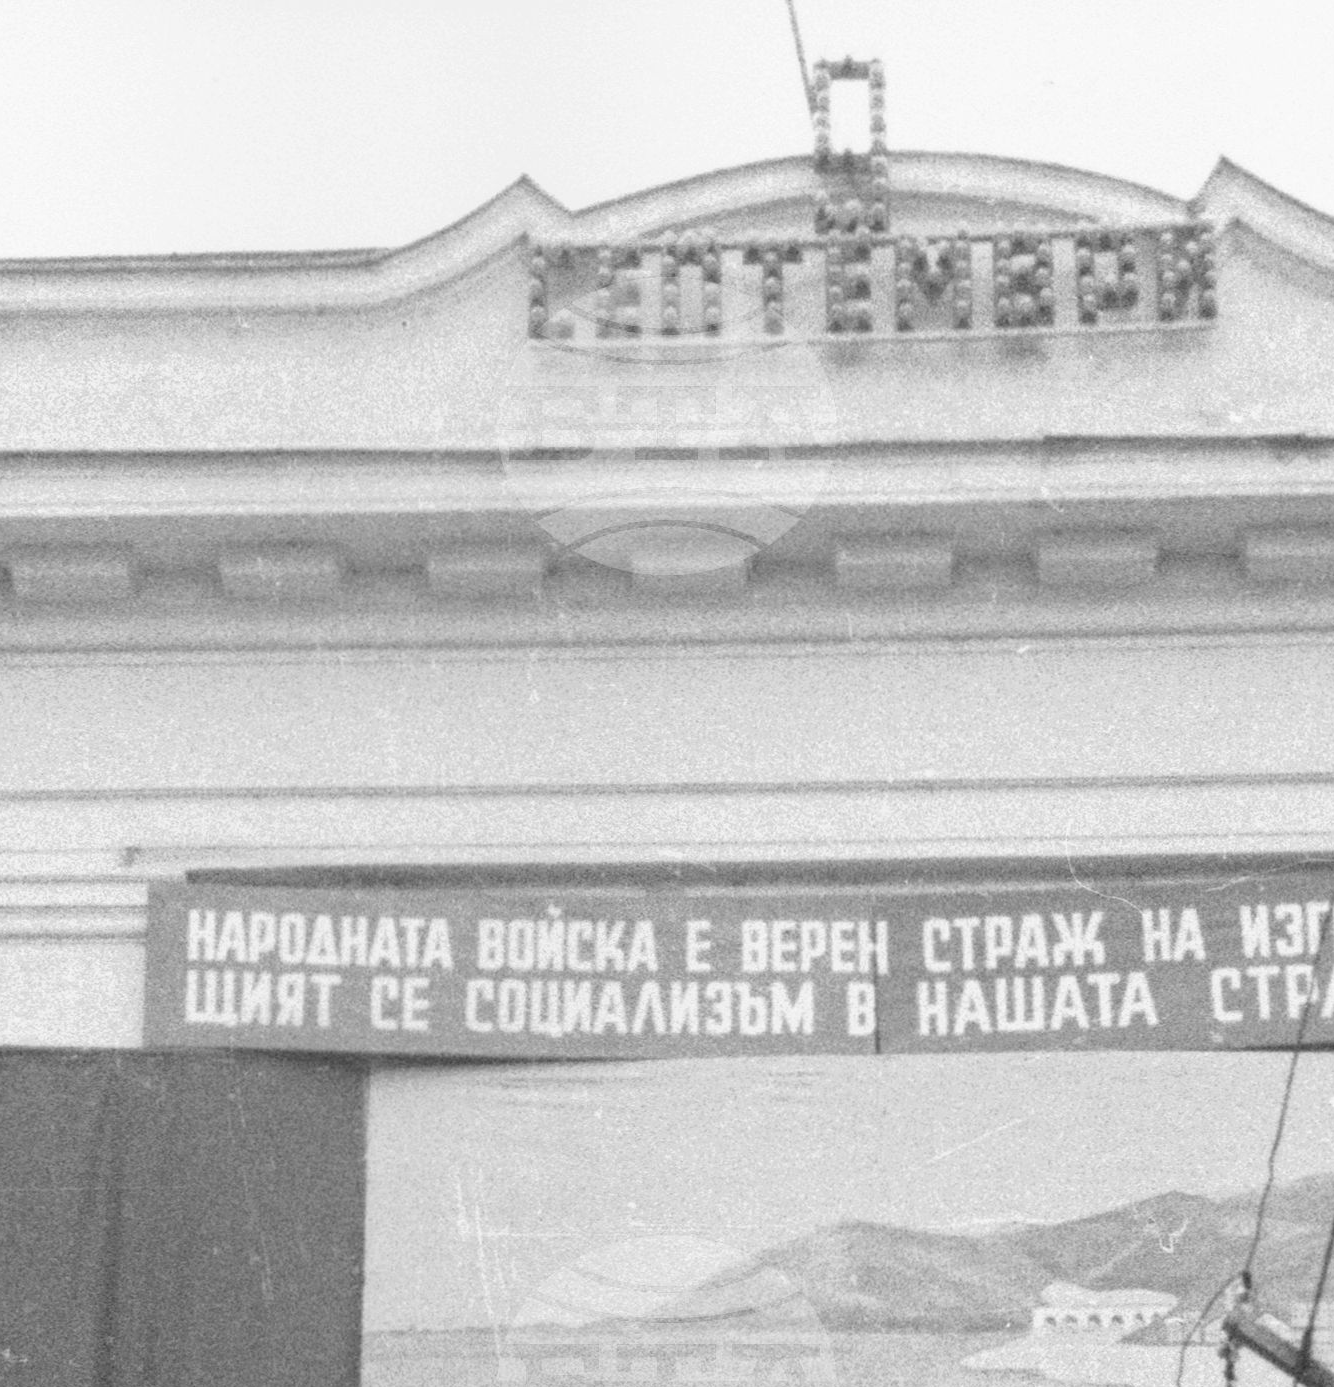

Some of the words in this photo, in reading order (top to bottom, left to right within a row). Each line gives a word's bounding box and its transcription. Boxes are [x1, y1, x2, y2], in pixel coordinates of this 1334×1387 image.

[185, 909, 454, 970] НАРОДНАТА
[476, 904, 658, 973] ВОЙСКА
[685, 919, 712, 973] Е
[742, 918, 889, 975] ВЕРЕН
[922, 910, 1106, 973] СТРАЖ
[1142, 907, 1206, 963] НА
[184, 969, 342, 1028] ЩИЯТ
[370, 974, 430, 1032] СЕ
[466, 978, 815, 1039] СОЦИАЛИЗЪМ
[847, 979, 878, 1037] В
[915, 972, 1160, 1037] НАШАТА
